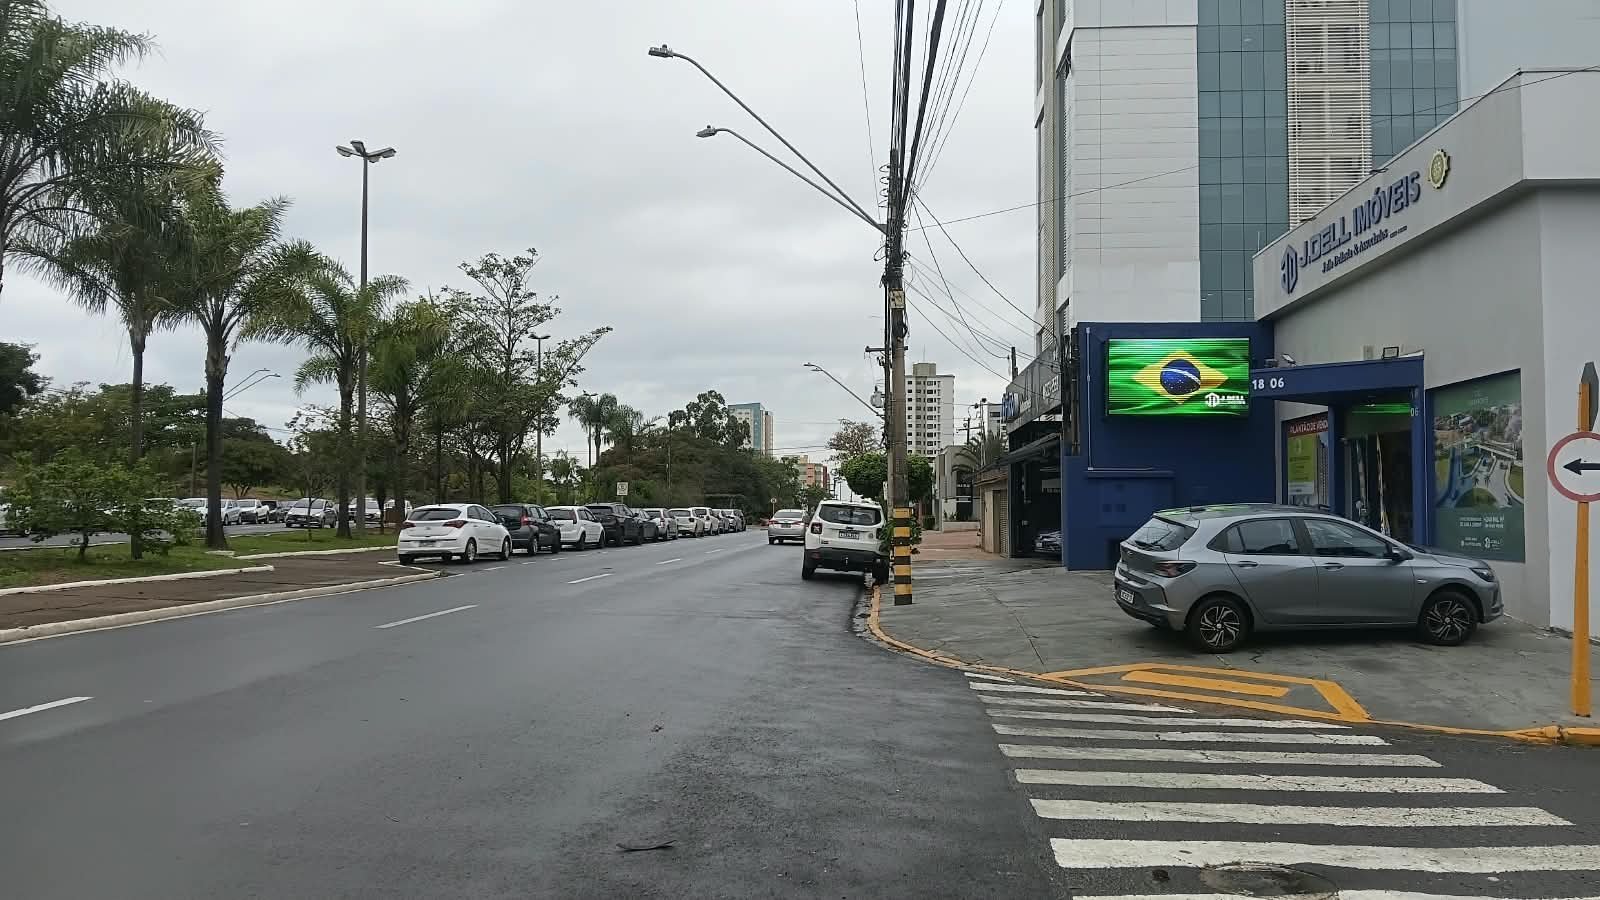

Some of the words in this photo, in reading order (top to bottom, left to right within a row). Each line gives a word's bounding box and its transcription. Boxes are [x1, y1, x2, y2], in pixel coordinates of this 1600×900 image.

[1300, 216, 1351, 269] J.DELL
[1353, 171, 1420, 236] IMÓVEIS
[1252, 379, 1265, 390] 18
[1270, 378, 1285, 389] 06
